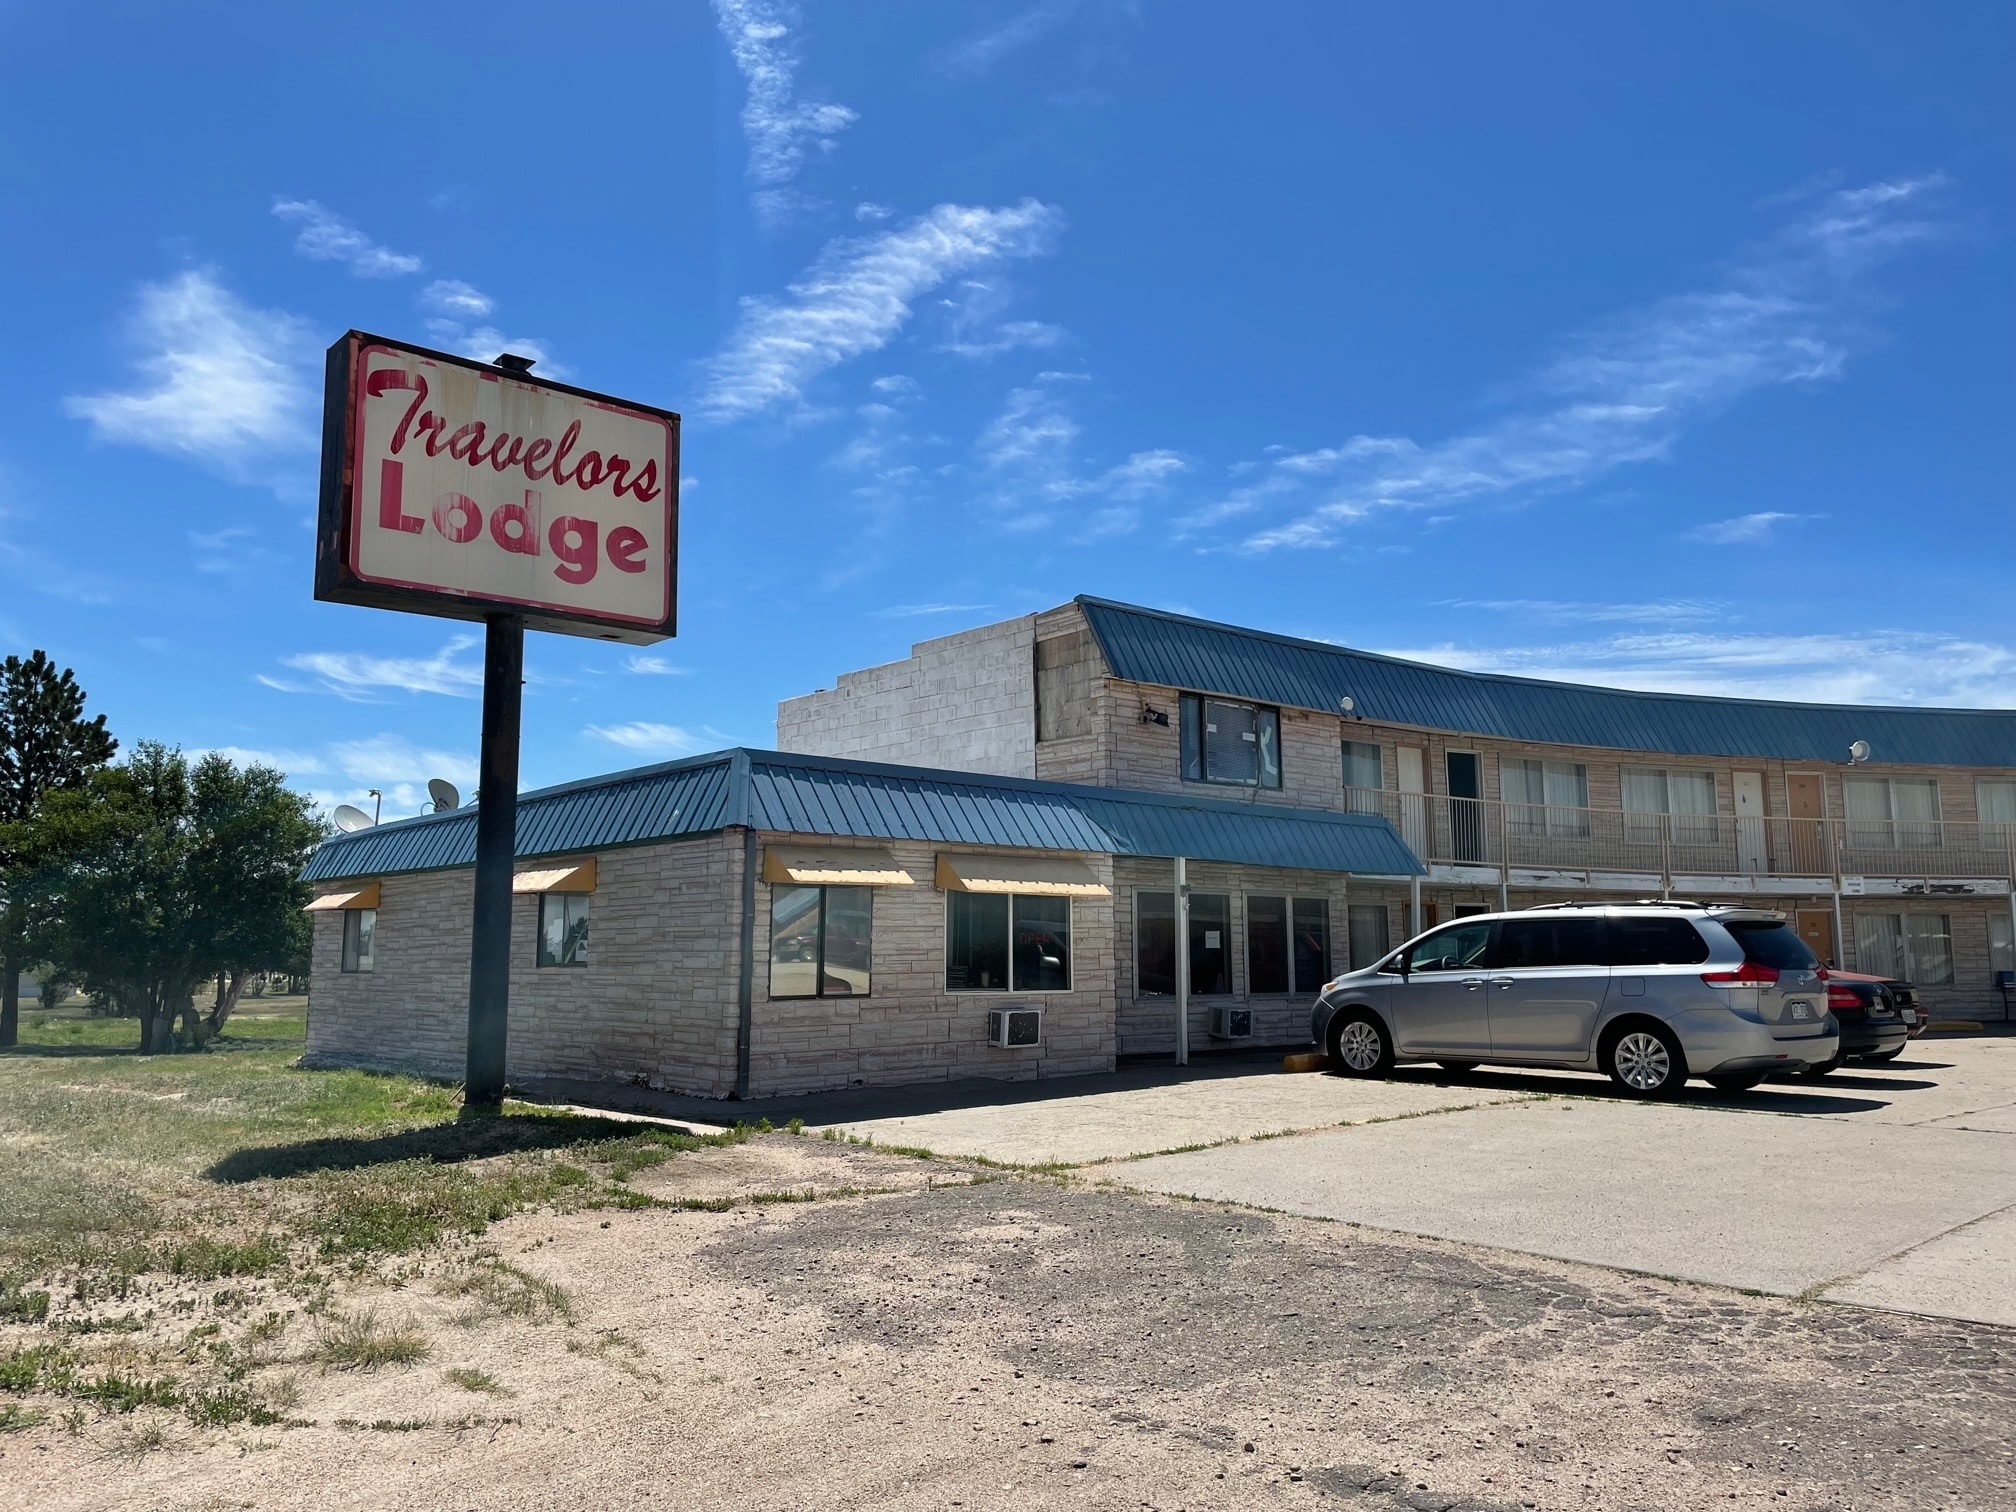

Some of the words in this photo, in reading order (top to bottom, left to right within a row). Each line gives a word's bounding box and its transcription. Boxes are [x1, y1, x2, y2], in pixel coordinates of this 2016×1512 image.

[367, 369, 661, 502] Travelors
[379, 459, 649, 584] Lodge
[1020, 932, 1049, 945] OPEN
